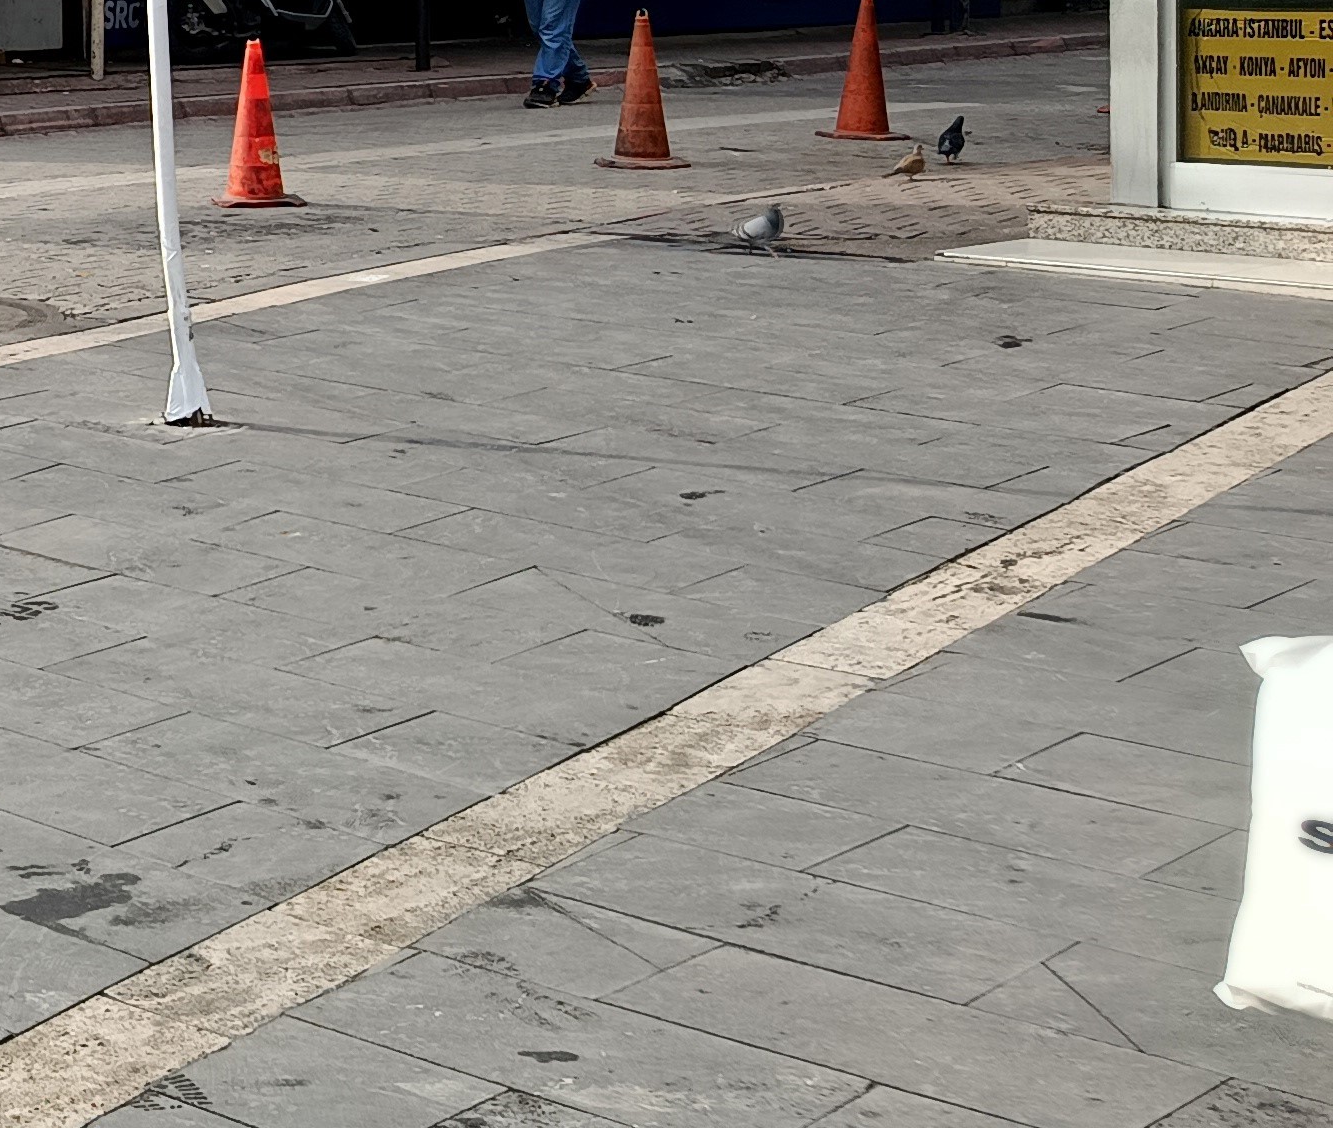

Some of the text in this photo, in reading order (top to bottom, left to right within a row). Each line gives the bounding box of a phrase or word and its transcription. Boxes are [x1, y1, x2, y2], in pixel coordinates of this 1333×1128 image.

[1239, 56, 1277, 77] KONYA
[1288, 57, 1326, 78] AFYON
[1257, 94, 1321, 118] ÇANAKKALE
